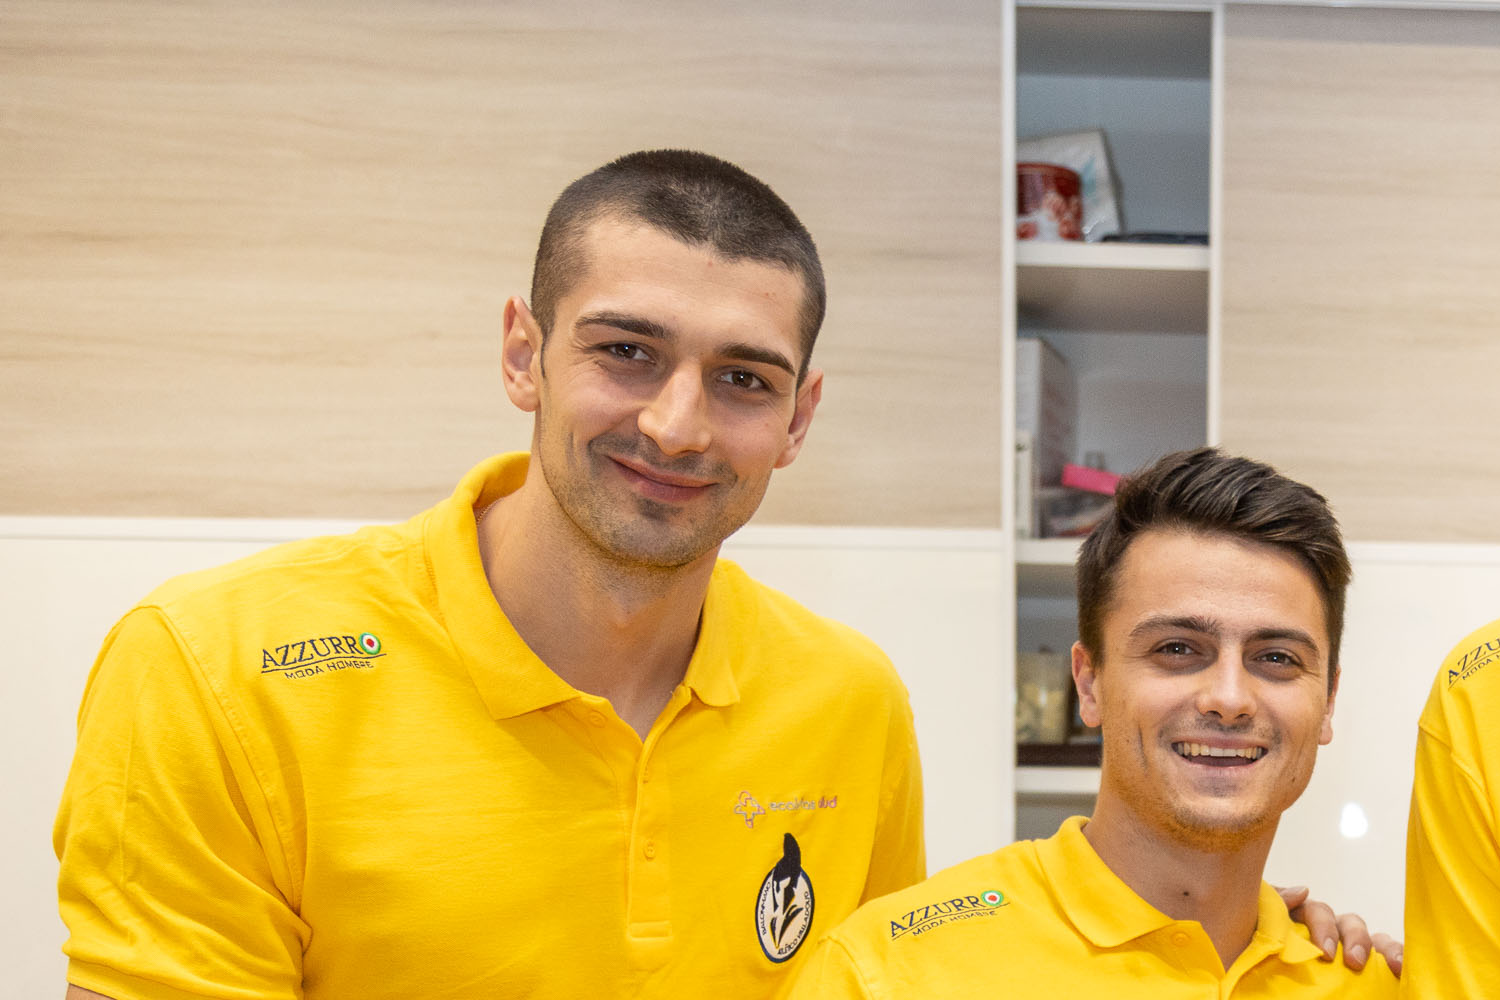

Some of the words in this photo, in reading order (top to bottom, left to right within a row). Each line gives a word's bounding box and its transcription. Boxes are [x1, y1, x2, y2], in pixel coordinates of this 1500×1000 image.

[262, 632, 382, 668] AZZURRO
[284, 666, 325, 680] MODA
[890, 890, 1004, 938] AZZURRO
[913, 919, 946, 936] MODA
